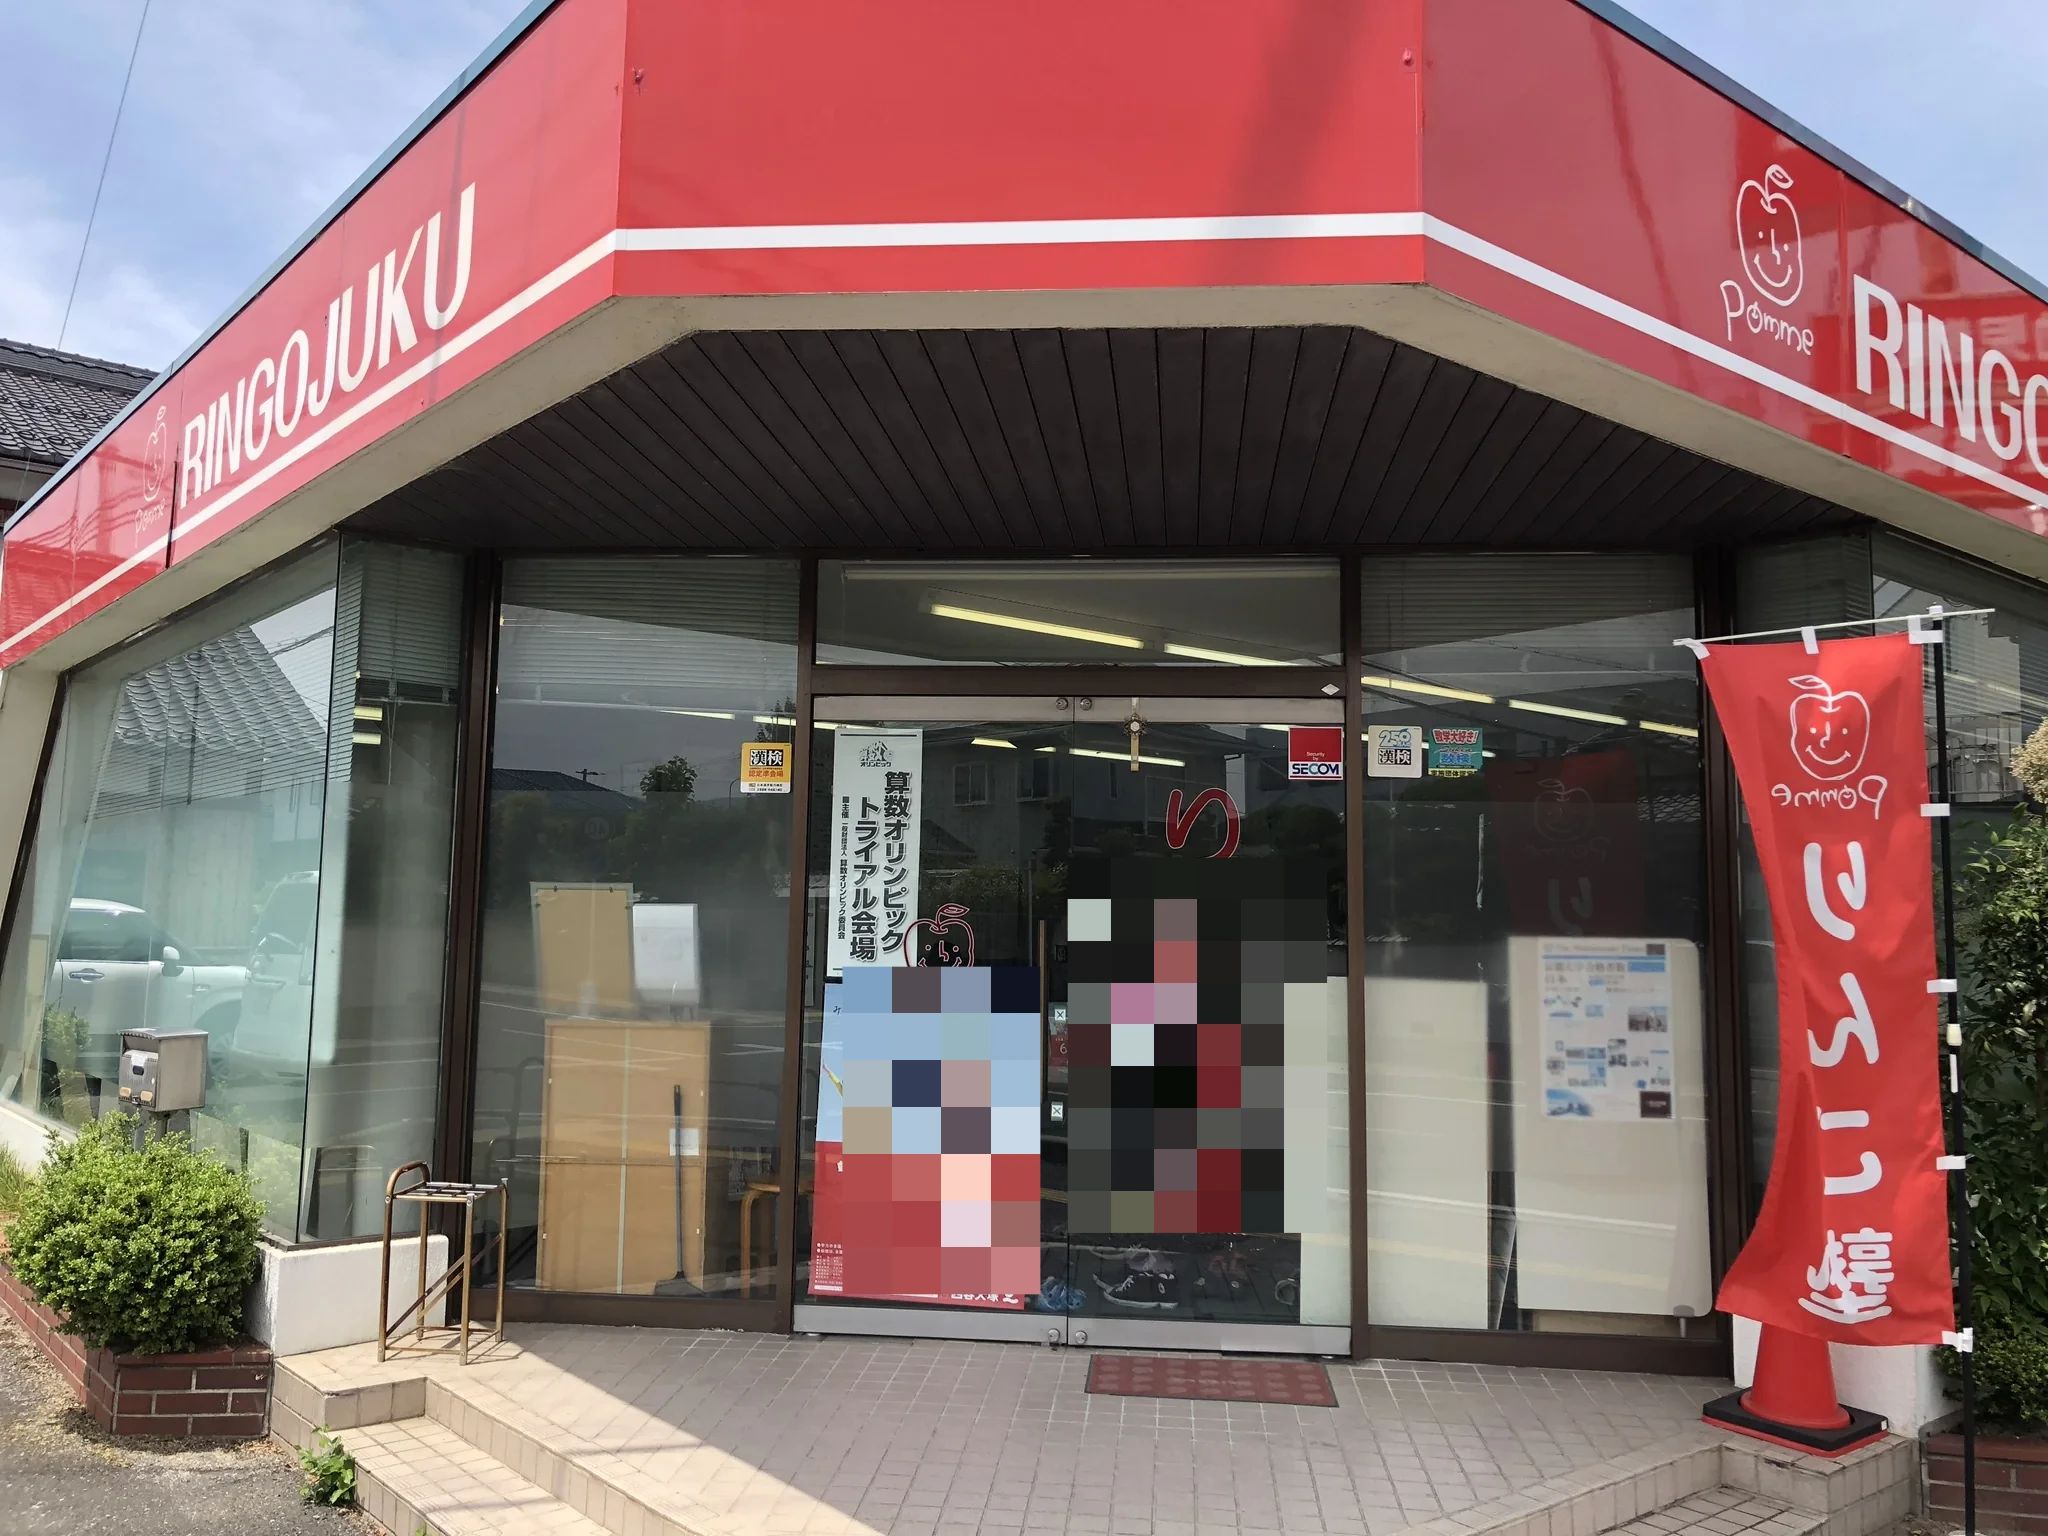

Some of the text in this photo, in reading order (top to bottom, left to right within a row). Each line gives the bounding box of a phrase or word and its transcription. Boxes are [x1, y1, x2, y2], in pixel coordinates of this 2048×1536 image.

[1720, 280, 1815, 356] Pomme
[750, 749, 783, 766] 漢検
[1292, 763, 1339, 775] SECOM
[1378, 748, 1412, 766] 漢検
[849, 797, 880, 962] トライアル会場
[881, 771, 911, 952] 算数オリンピック
